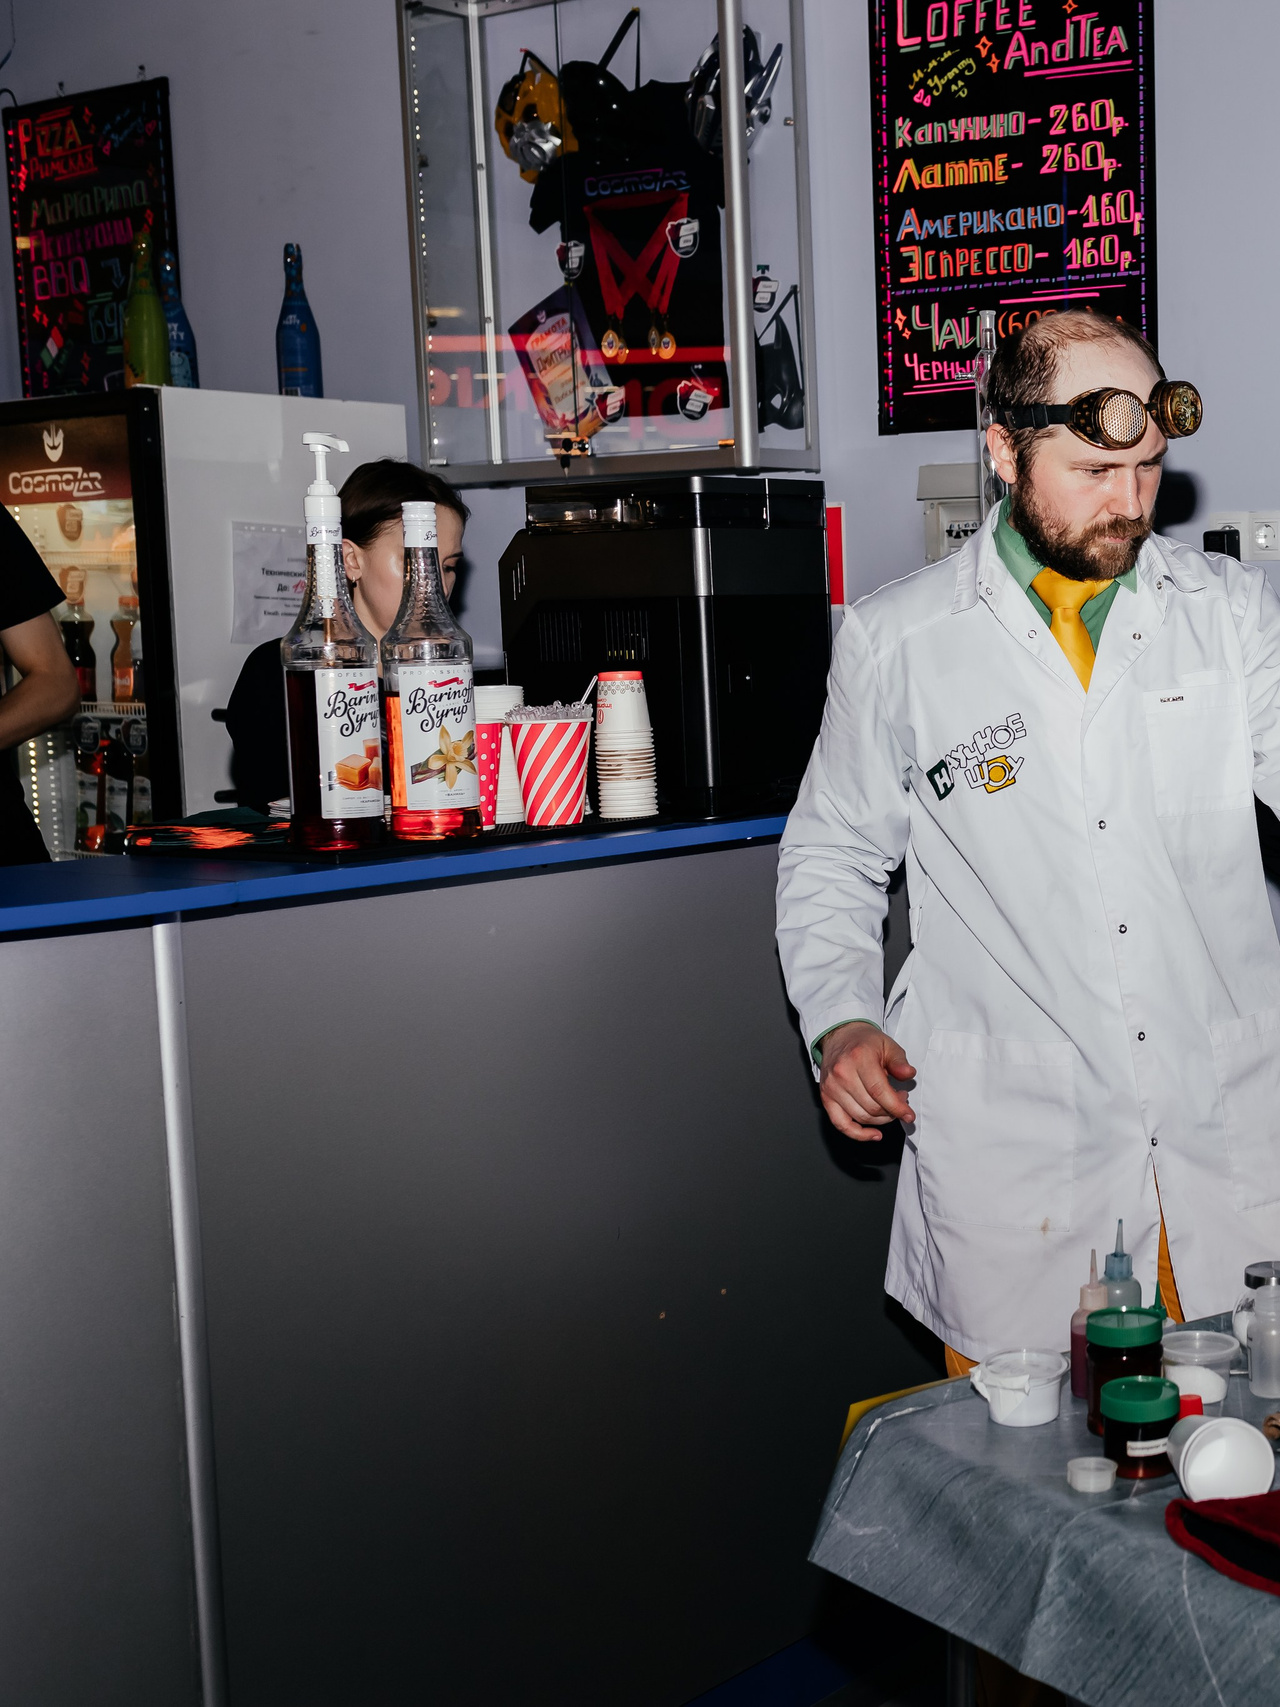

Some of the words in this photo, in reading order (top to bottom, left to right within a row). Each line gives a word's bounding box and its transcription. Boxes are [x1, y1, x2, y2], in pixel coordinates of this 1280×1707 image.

[32, 256, 91, 301] BBQ
[420, 703, 468, 733] Syrup
[931, 712, 1027, 798] НАУЧНОЕ
[963, 756, 1025, 789] ШОУ
